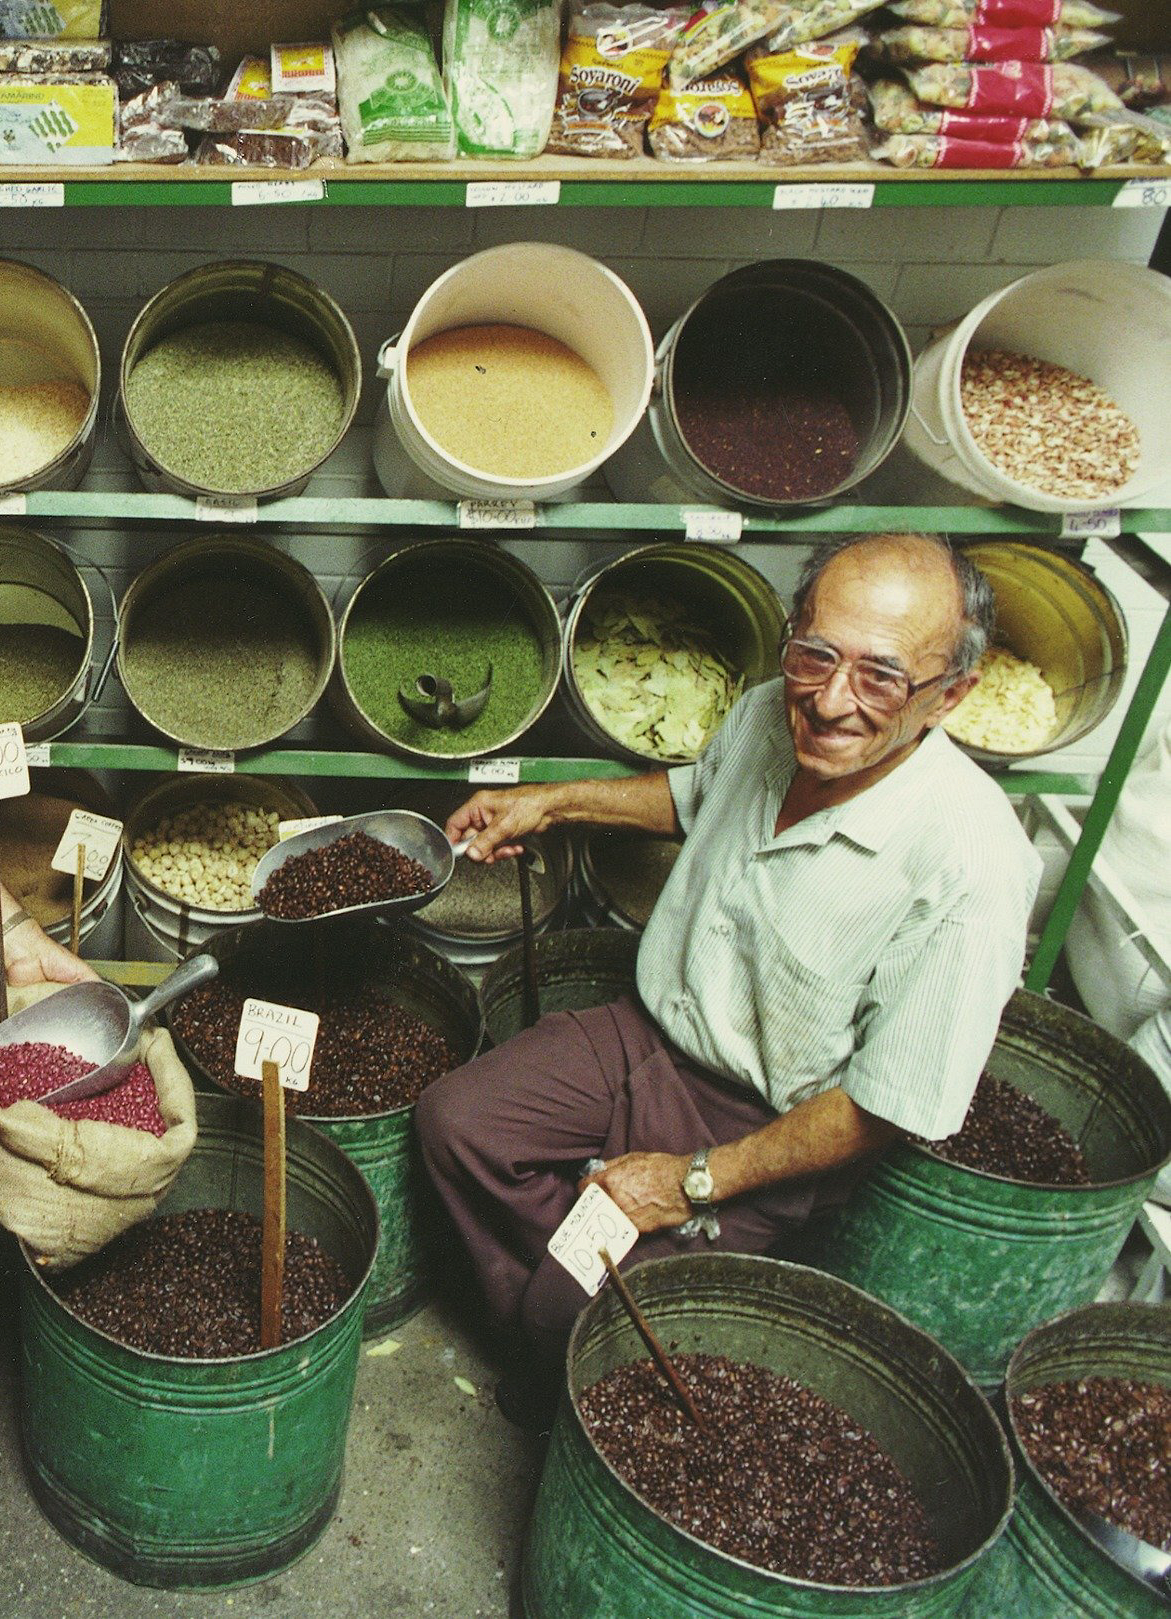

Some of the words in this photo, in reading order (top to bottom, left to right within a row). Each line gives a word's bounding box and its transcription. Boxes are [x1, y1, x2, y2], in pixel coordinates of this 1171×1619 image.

[570, 66, 640, 95] Soyaroni
[248, 1003, 302, 1028] BRAZIL
[550, 1229, 570, 1254] BLUE
